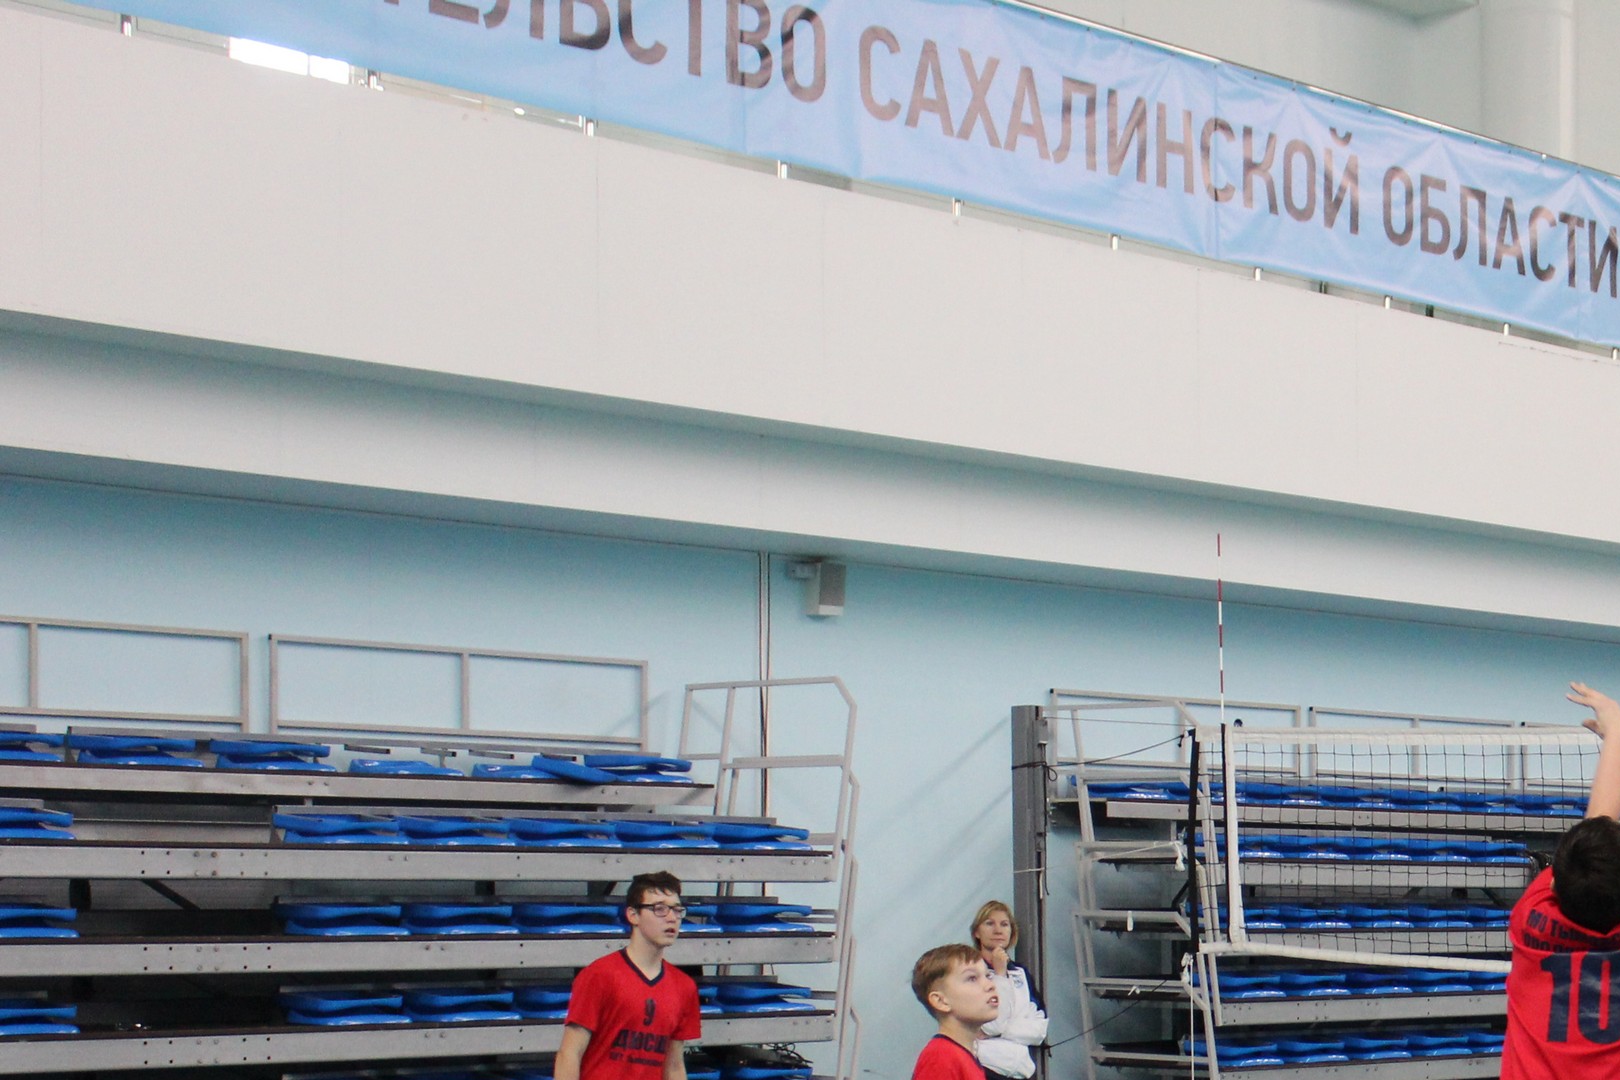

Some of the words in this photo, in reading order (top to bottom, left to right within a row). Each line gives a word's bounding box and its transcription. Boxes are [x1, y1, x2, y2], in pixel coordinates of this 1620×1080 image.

[858, 25, 1360, 235] САХАЛИНСКОЙ
[1382, 166, 1620, 298] ОБЛАСТИ
[642, 998, 656, 1027] 9
